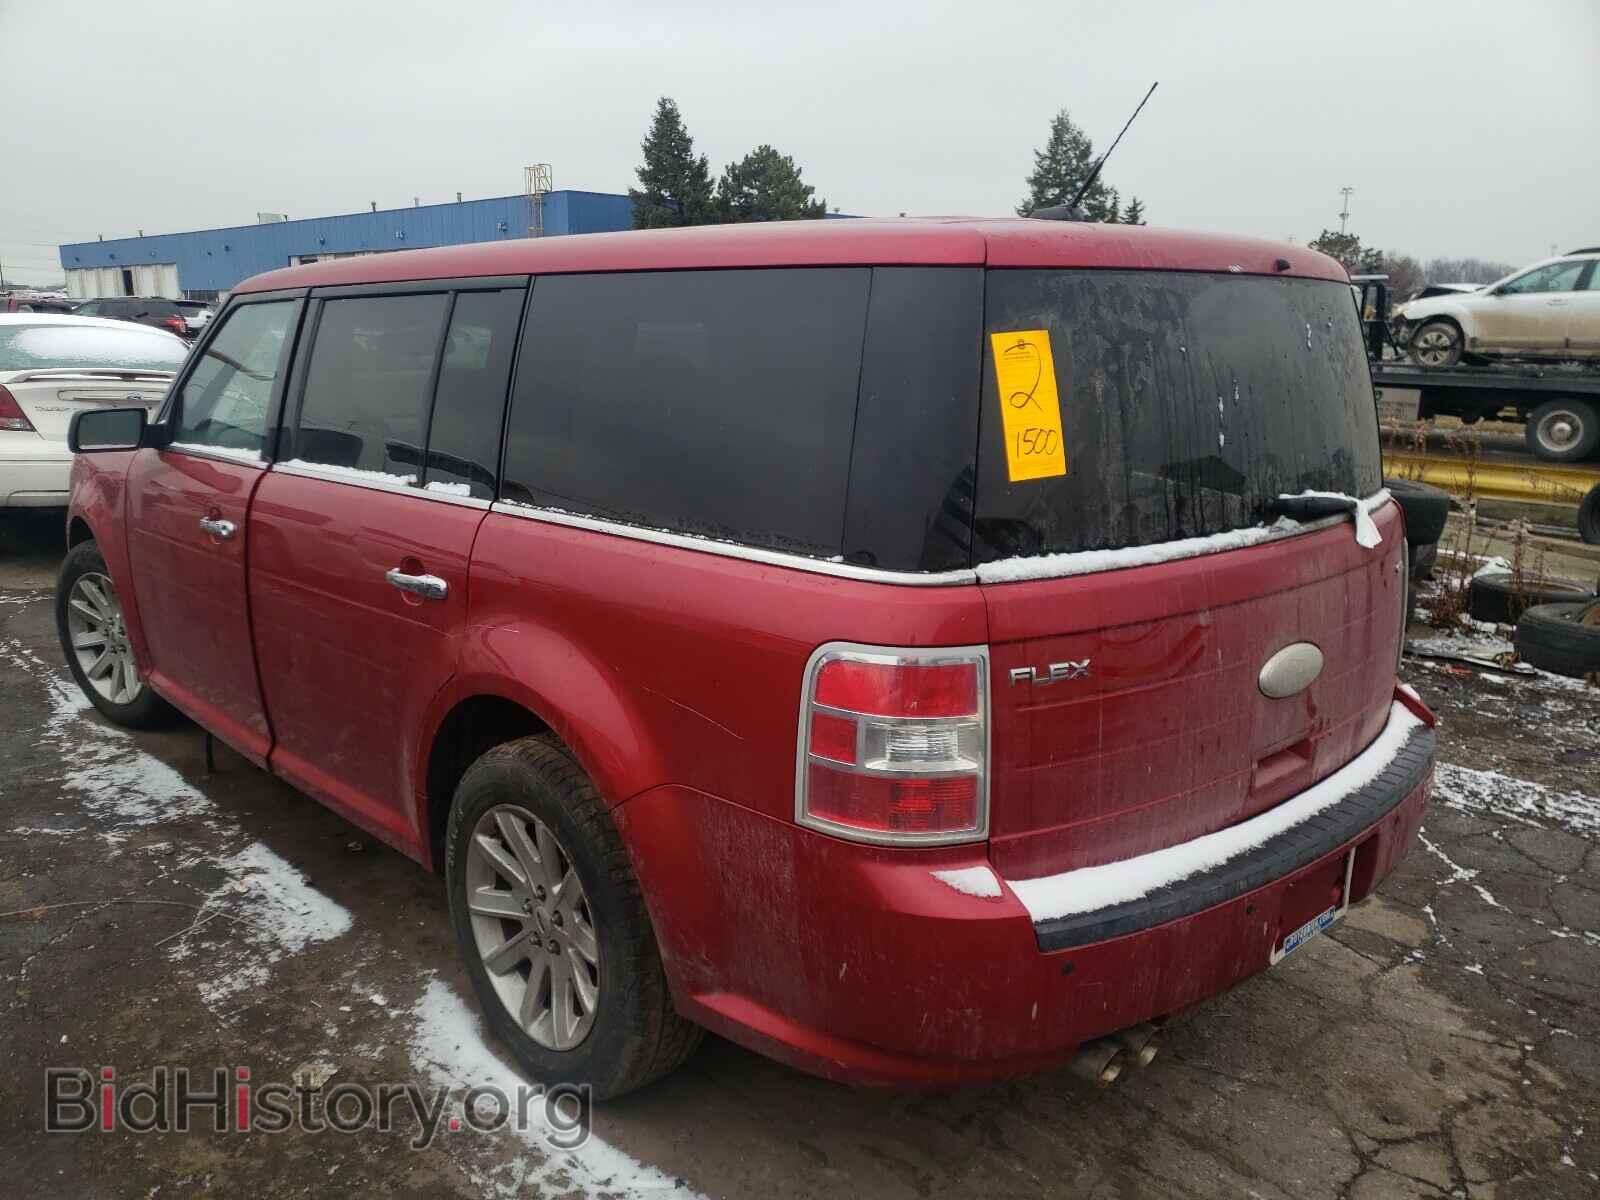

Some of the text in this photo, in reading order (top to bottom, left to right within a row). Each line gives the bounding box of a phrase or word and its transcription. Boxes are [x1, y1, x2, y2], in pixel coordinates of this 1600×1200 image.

[1004, 342, 1043, 412] 2
[1016, 428, 1058, 459] 1500
[1009, 658, 1091, 688] FLEX
